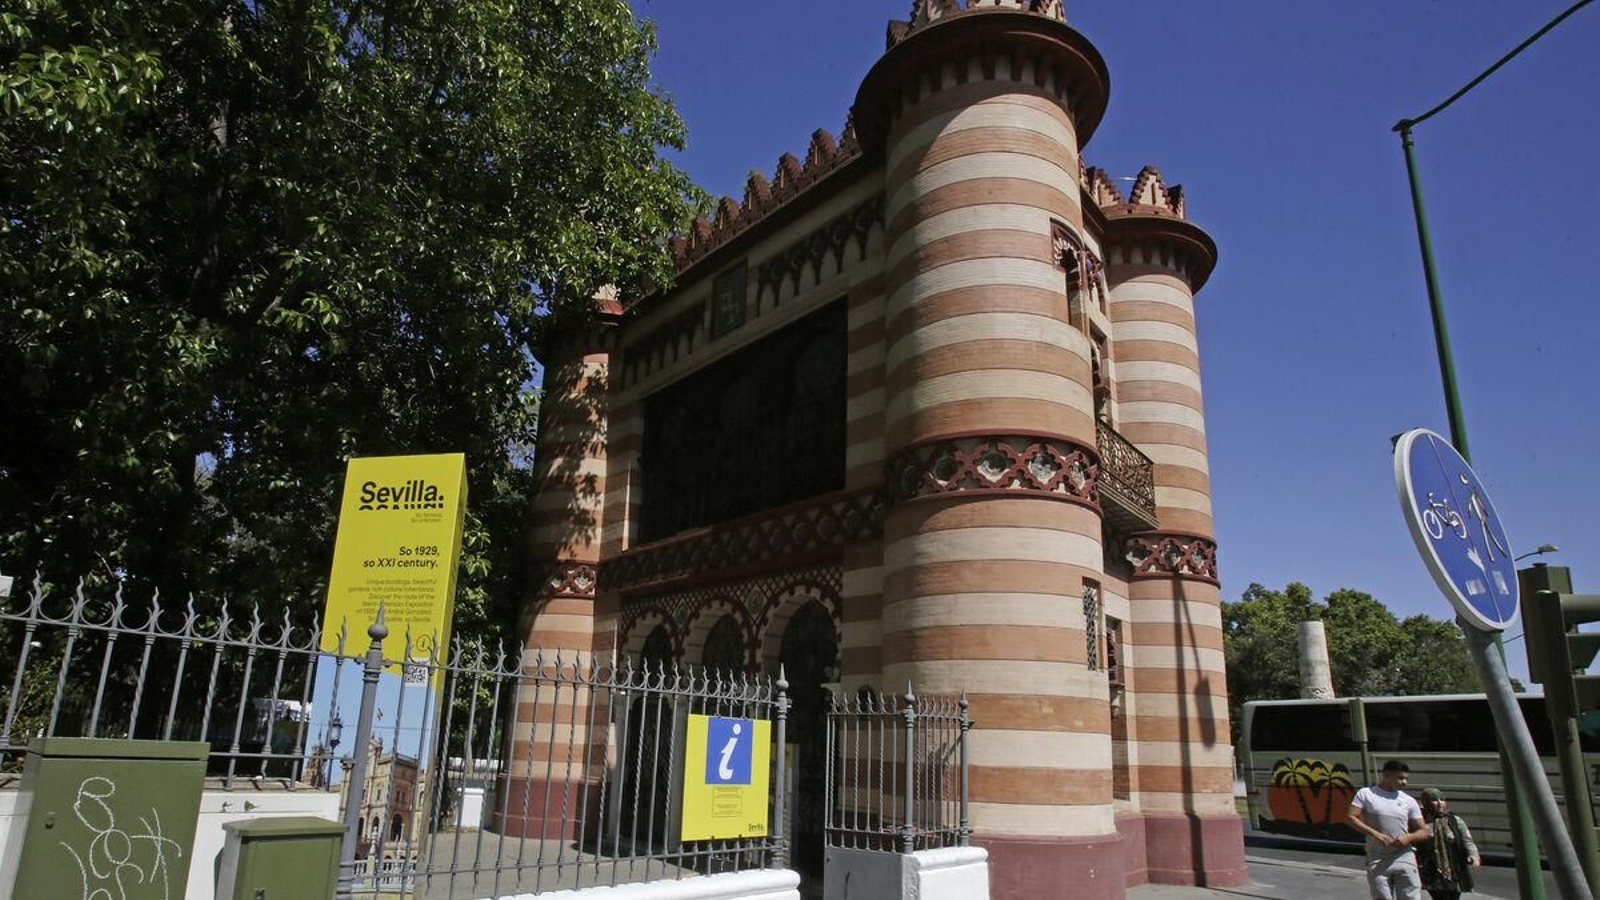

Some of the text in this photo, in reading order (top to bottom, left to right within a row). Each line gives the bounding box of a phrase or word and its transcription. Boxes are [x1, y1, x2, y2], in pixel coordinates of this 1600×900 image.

[360, 479, 444, 503] Sevilla.
[399, 546, 440, 557] So 1929,
[363, 558, 438, 569] so XXI century.
[718, 723, 741, 780] i
